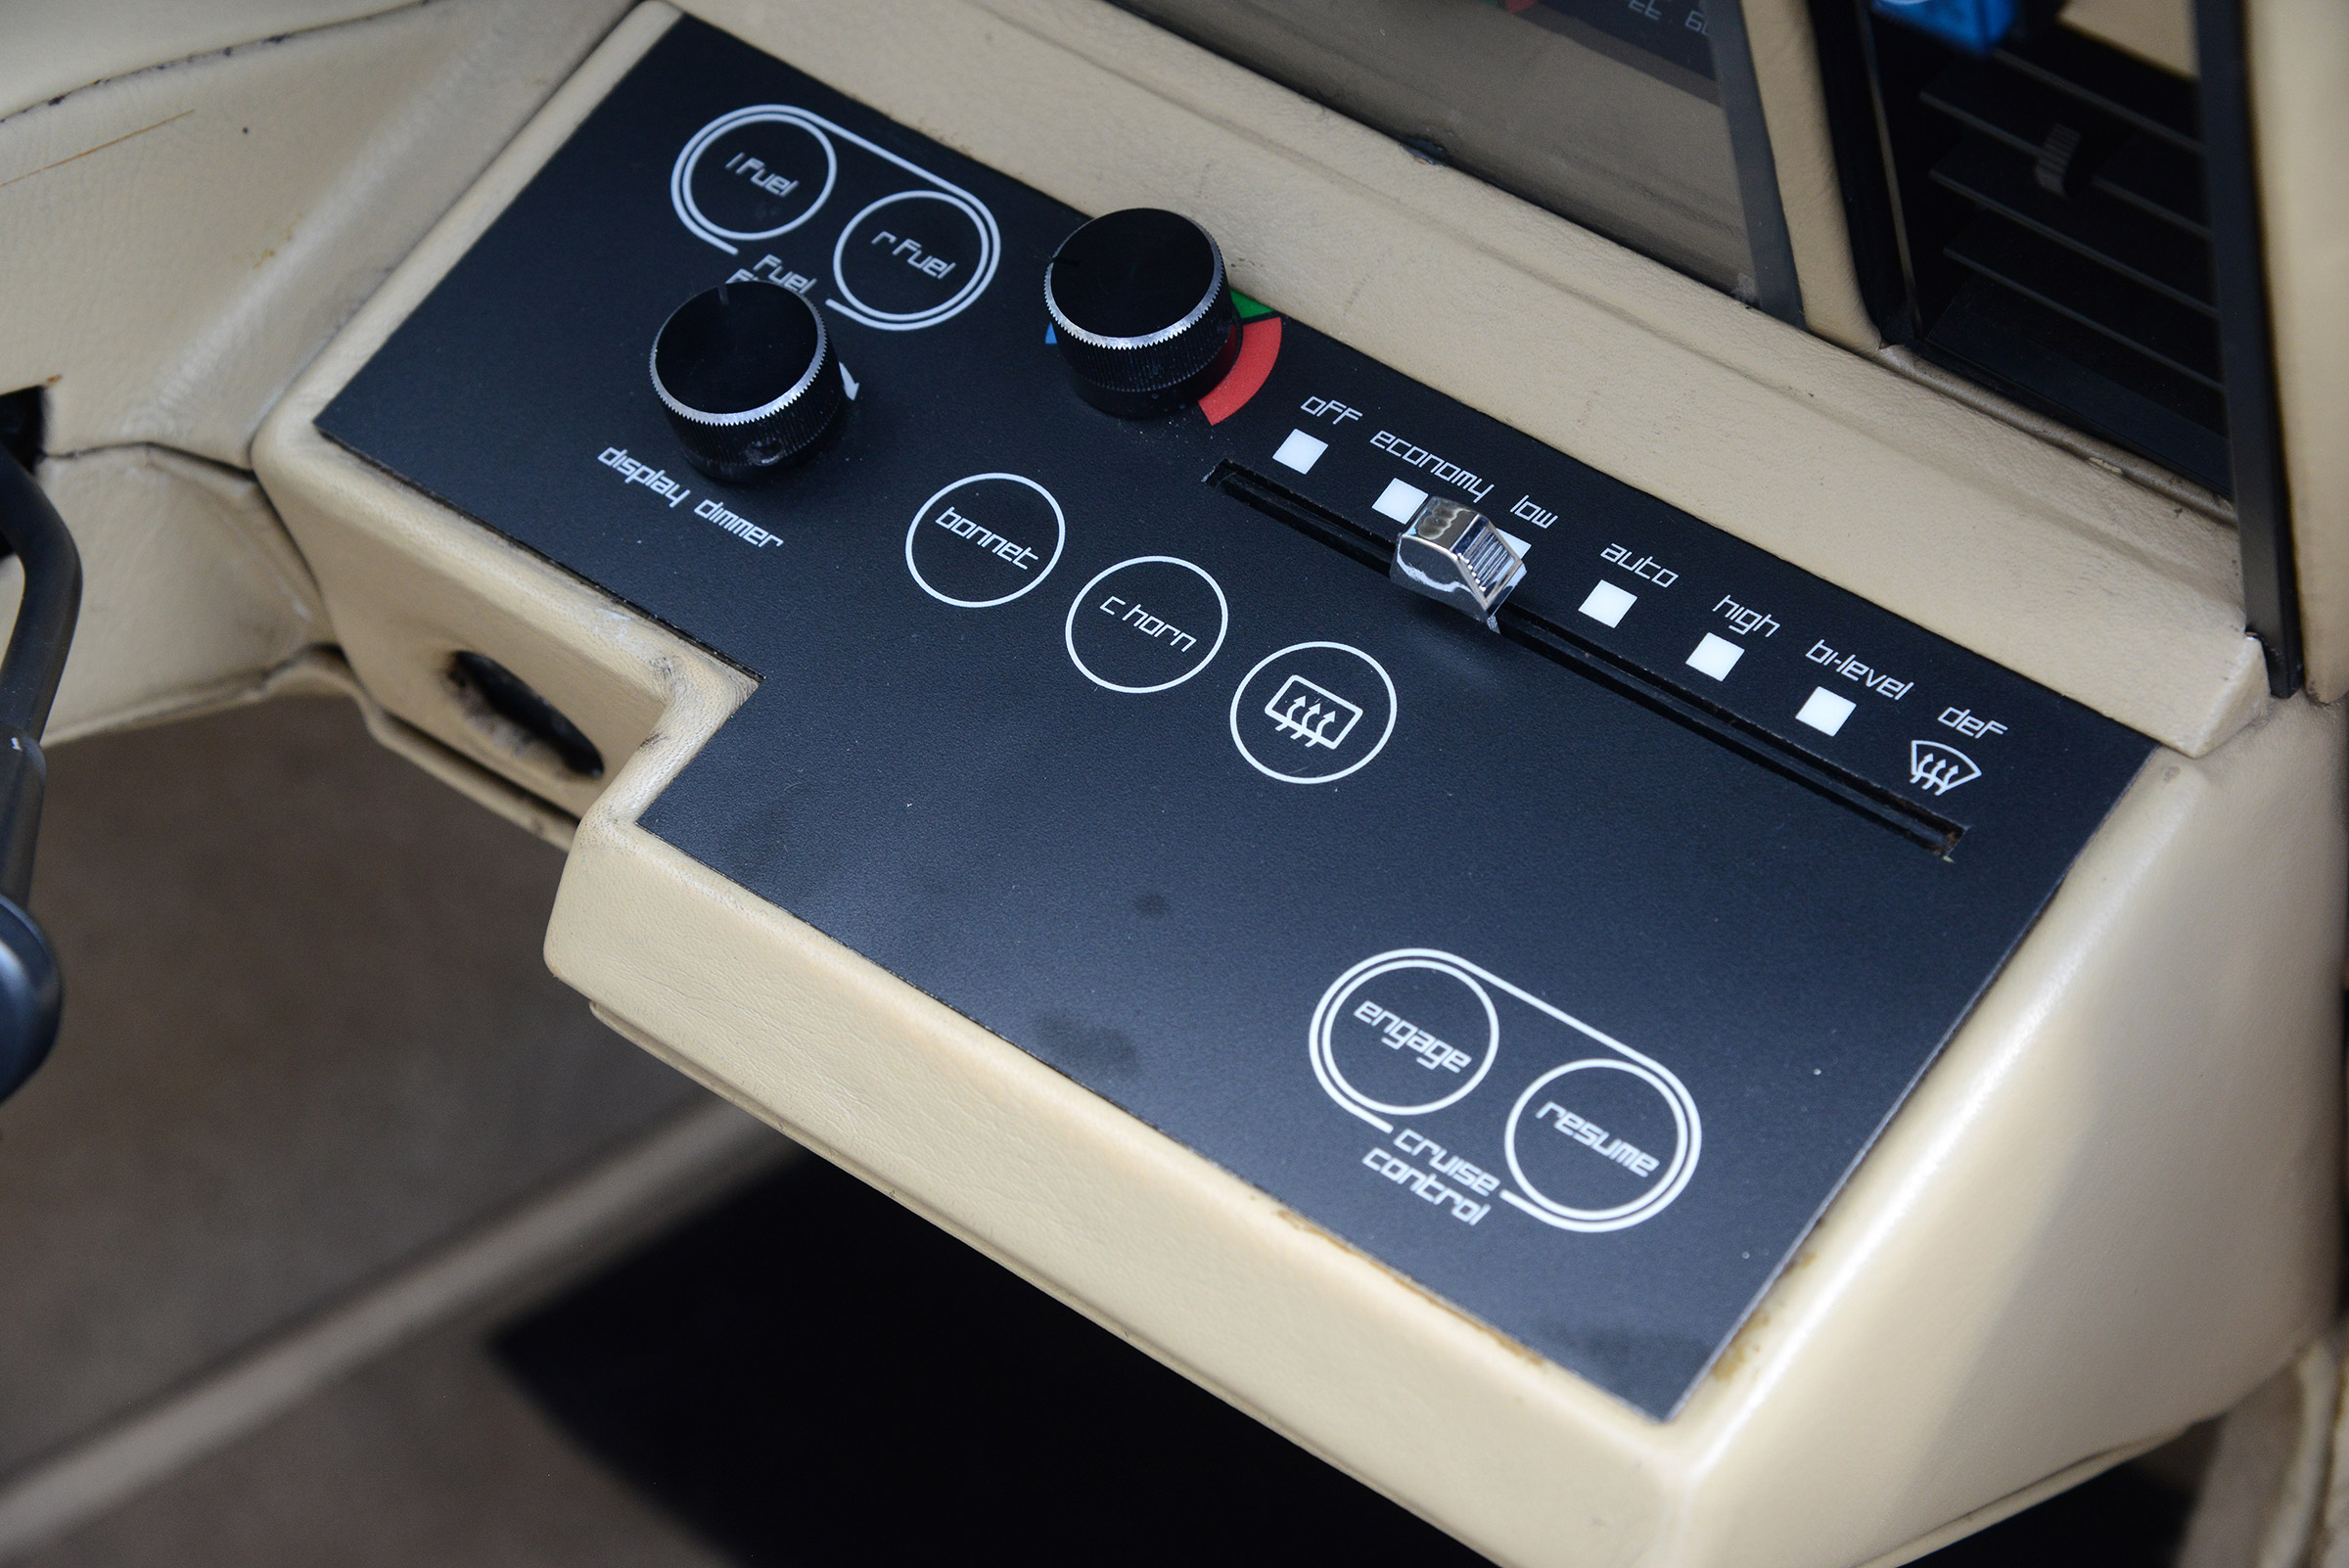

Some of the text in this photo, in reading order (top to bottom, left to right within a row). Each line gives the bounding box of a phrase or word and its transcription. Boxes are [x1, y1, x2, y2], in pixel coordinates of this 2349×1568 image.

[597, 446, 784, 548] display dimmer
[1369, 430, 1496, 504] economy
[935, 506, 1039, 571] bonnet
[1509, 494, 1559, 530] low
[1599, 542, 1680, 588] auto
[1122, 603, 1197, 653] horn
[1712, 594, 1781, 638] high
[1805, 638, 1914, 701] bi-level
[1353, 1000, 1472, 1074] engage
[1393, 1129, 1500, 1197] cruise
[1536, 1101, 1660, 1177] resume
[1361, 1147, 1492, 1226] control
